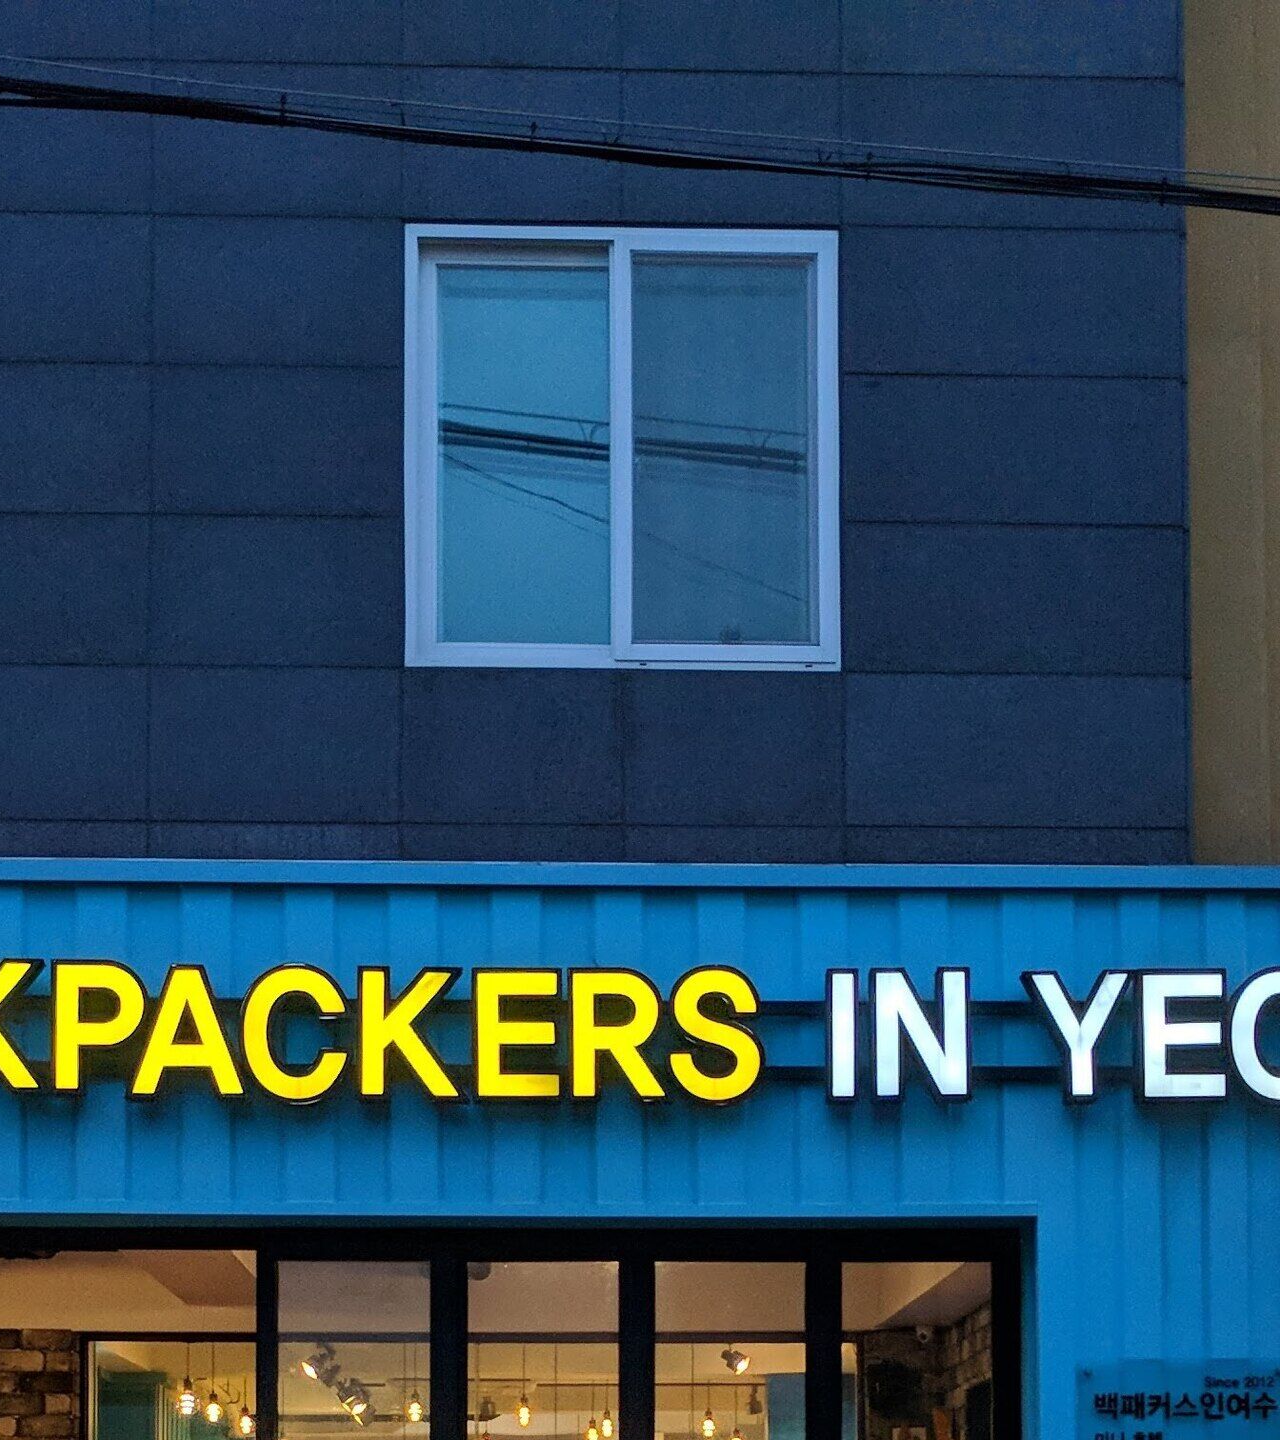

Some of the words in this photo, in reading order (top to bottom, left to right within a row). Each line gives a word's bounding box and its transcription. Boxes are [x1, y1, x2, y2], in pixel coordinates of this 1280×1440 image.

[825, 967, 971, 1103] IN
[1204, 1376, 1239, 1388] Since
[1244, 1376, 1275, 1388] 2012
[1094, 1391, 1278, 1420] 백패커스인여수
